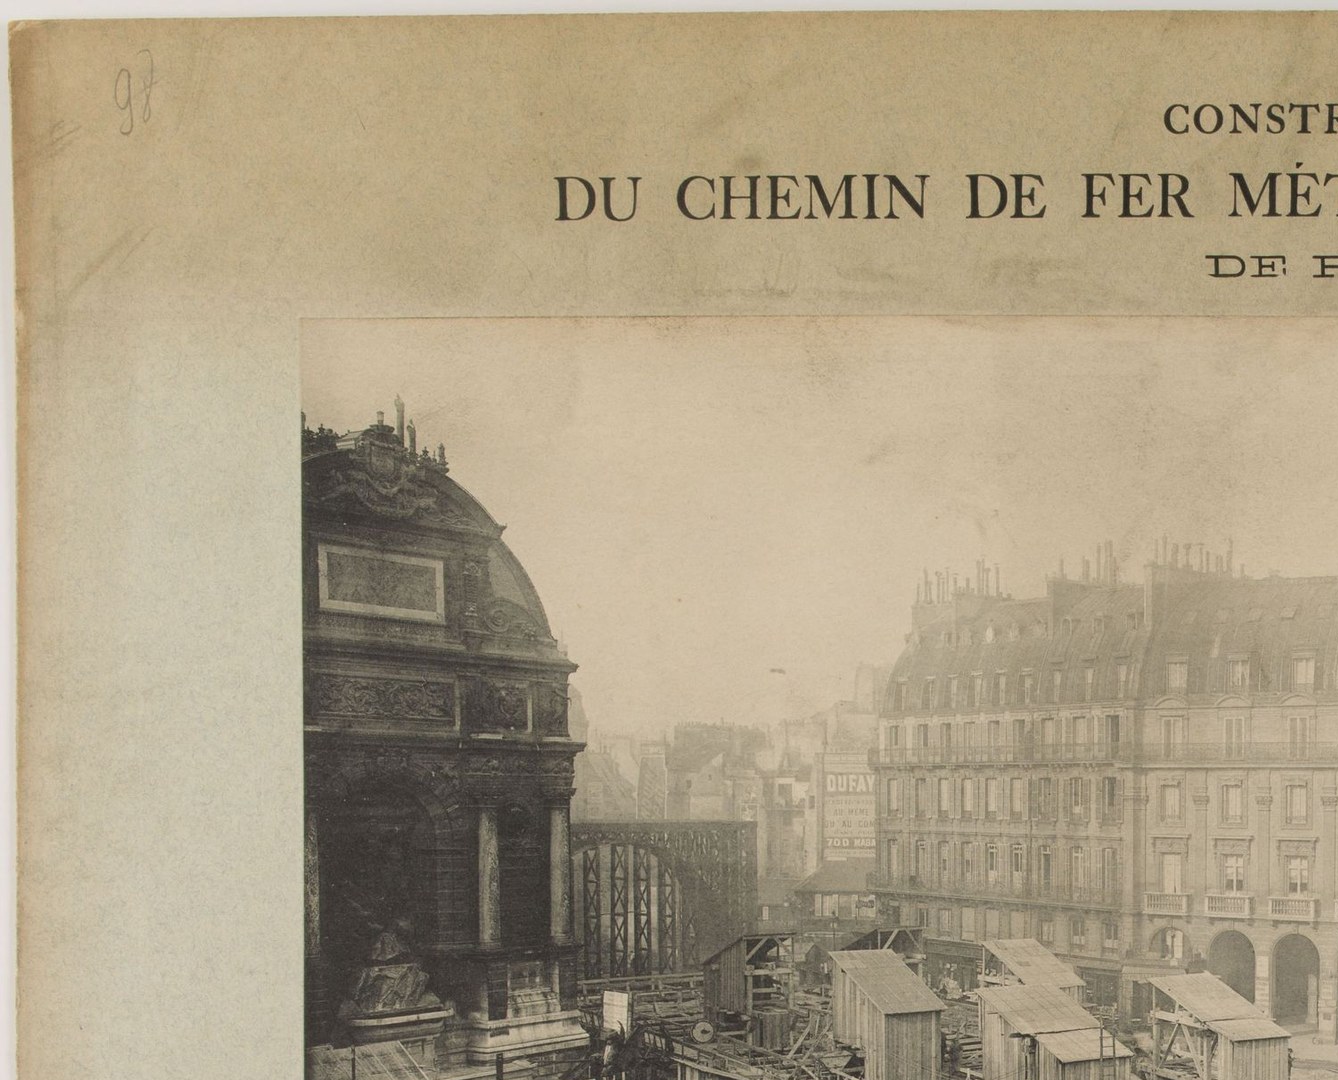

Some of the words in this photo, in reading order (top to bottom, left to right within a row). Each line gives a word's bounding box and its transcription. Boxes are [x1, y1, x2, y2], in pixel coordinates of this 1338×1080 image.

[553, 176, 643, 222] DU
[676, 173, 931, 221] CHEMIN
[965, 173, 1047, 220] DE
[1080, 172, 1196, 219] FER
[1204, 254, 1287, 279] DE
[826, 775, 876, 792] DUFAY
